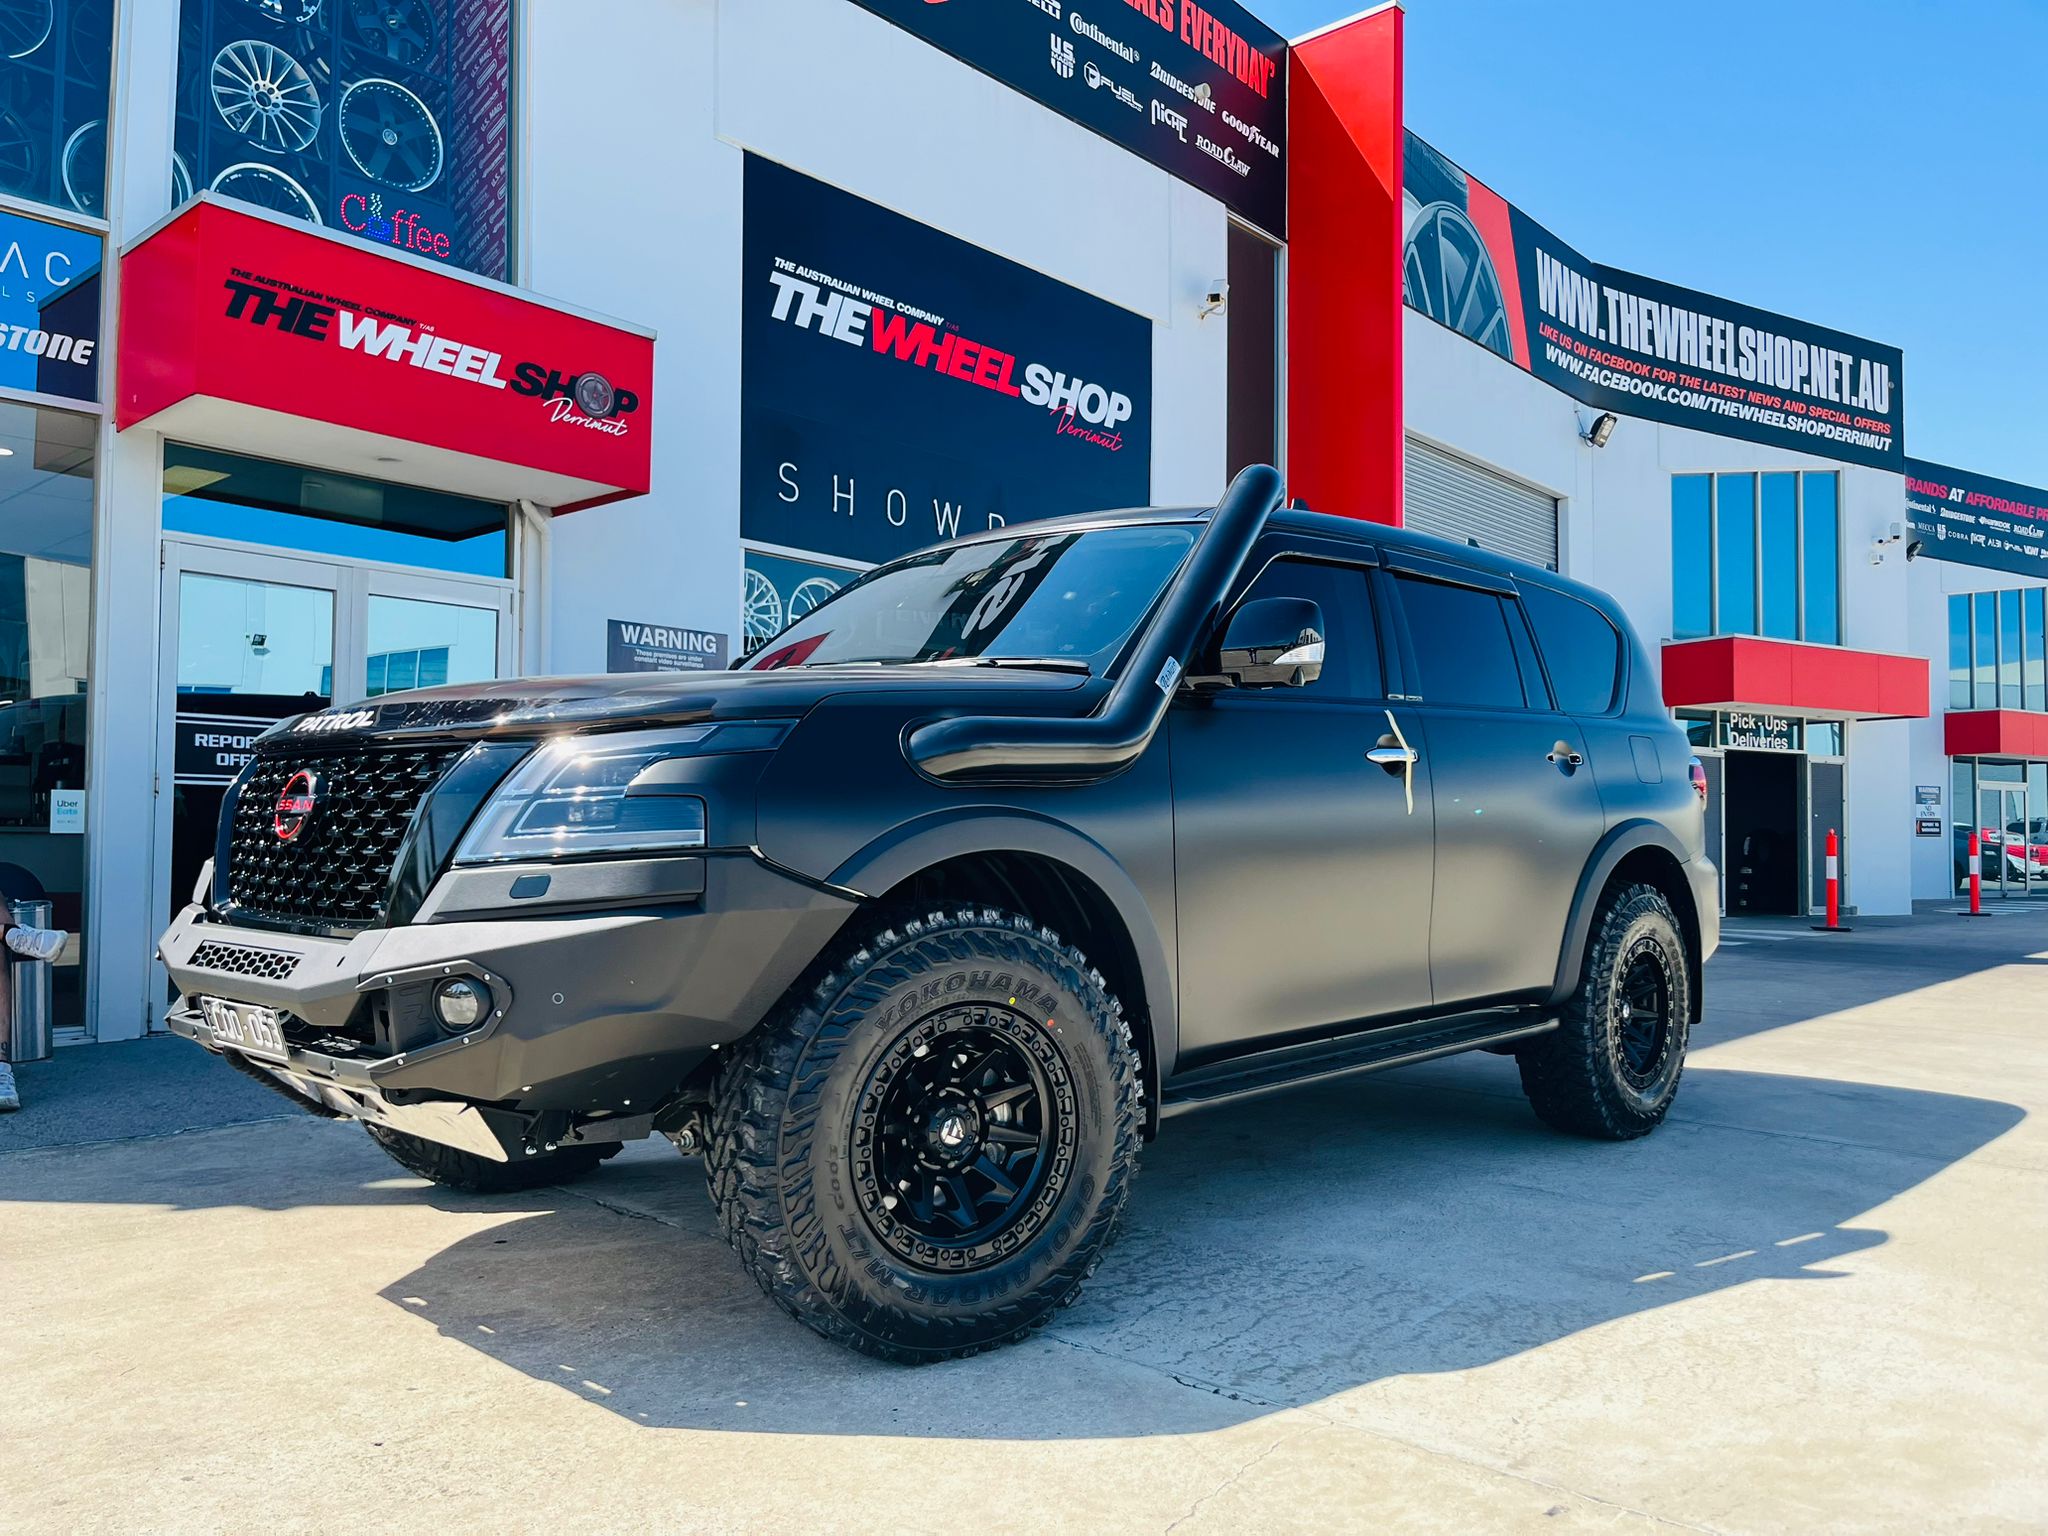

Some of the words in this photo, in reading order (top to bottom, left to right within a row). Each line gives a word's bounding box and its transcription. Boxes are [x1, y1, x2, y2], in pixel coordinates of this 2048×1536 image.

[1069, 11, 1135, 64] Continental
[230, 267, 252, 280] THE
[253, 274, 324, 300] AUSTRALIAN
[325, 295, 362, 312] WHEEL
[364, 307, 417, 327] COMPANY
[774, 256, 796, 273] THE
[796, 265, 861, 297] AUSTRALIAN
[861, 288, 895, 309] WHEEL
[896, 302, 944, 326] COMPANY
[224, 279, 336, 342] THE
[340, 310, 506, 389] WHEEL
[769, 270, 873, 347] THE
[872, 306, 1020, 398] WHEEL
[1020, 362, 1132, 430] SHOP
[1539, 321, 1559, 343] LIKE
[1559, 332, 1573, 350] US
[1573, 340, 1588, 357] ON
[1588, 348, 1651, 377] FACEBOOK
[1652, 368, 1677, 384] FOR
[1678, 374, 1701, 390] THE
[1703, 378, 1747, 399] LATEST
[1748, 391, 1781, 409] NEWS
[1783, 400, 1807, 415] AND
[1808, 405, 1852, 426] SPECIAL
[1854, 417, 1891, 434] OFFERS
[543, 397, 628, 436] Derrimut
[1050, 405, 1123, 452] Derrimut
[1948, 487, 1965, 503] AT
[1965, 492, 2035, 519] AFFORDABLE
[1948, 531, 1968, 540] COBRA
[620, 624, 717, 654] WARNING
[292, 710, 374, 732] PATROL
[1730, 712, 1756, 729] Pick
[1764, 715, 1788, 734] Ups
[1730, 731, 1788, 749] Deliveries
[875, 970, 1059, 1031] YOKOHAMA
